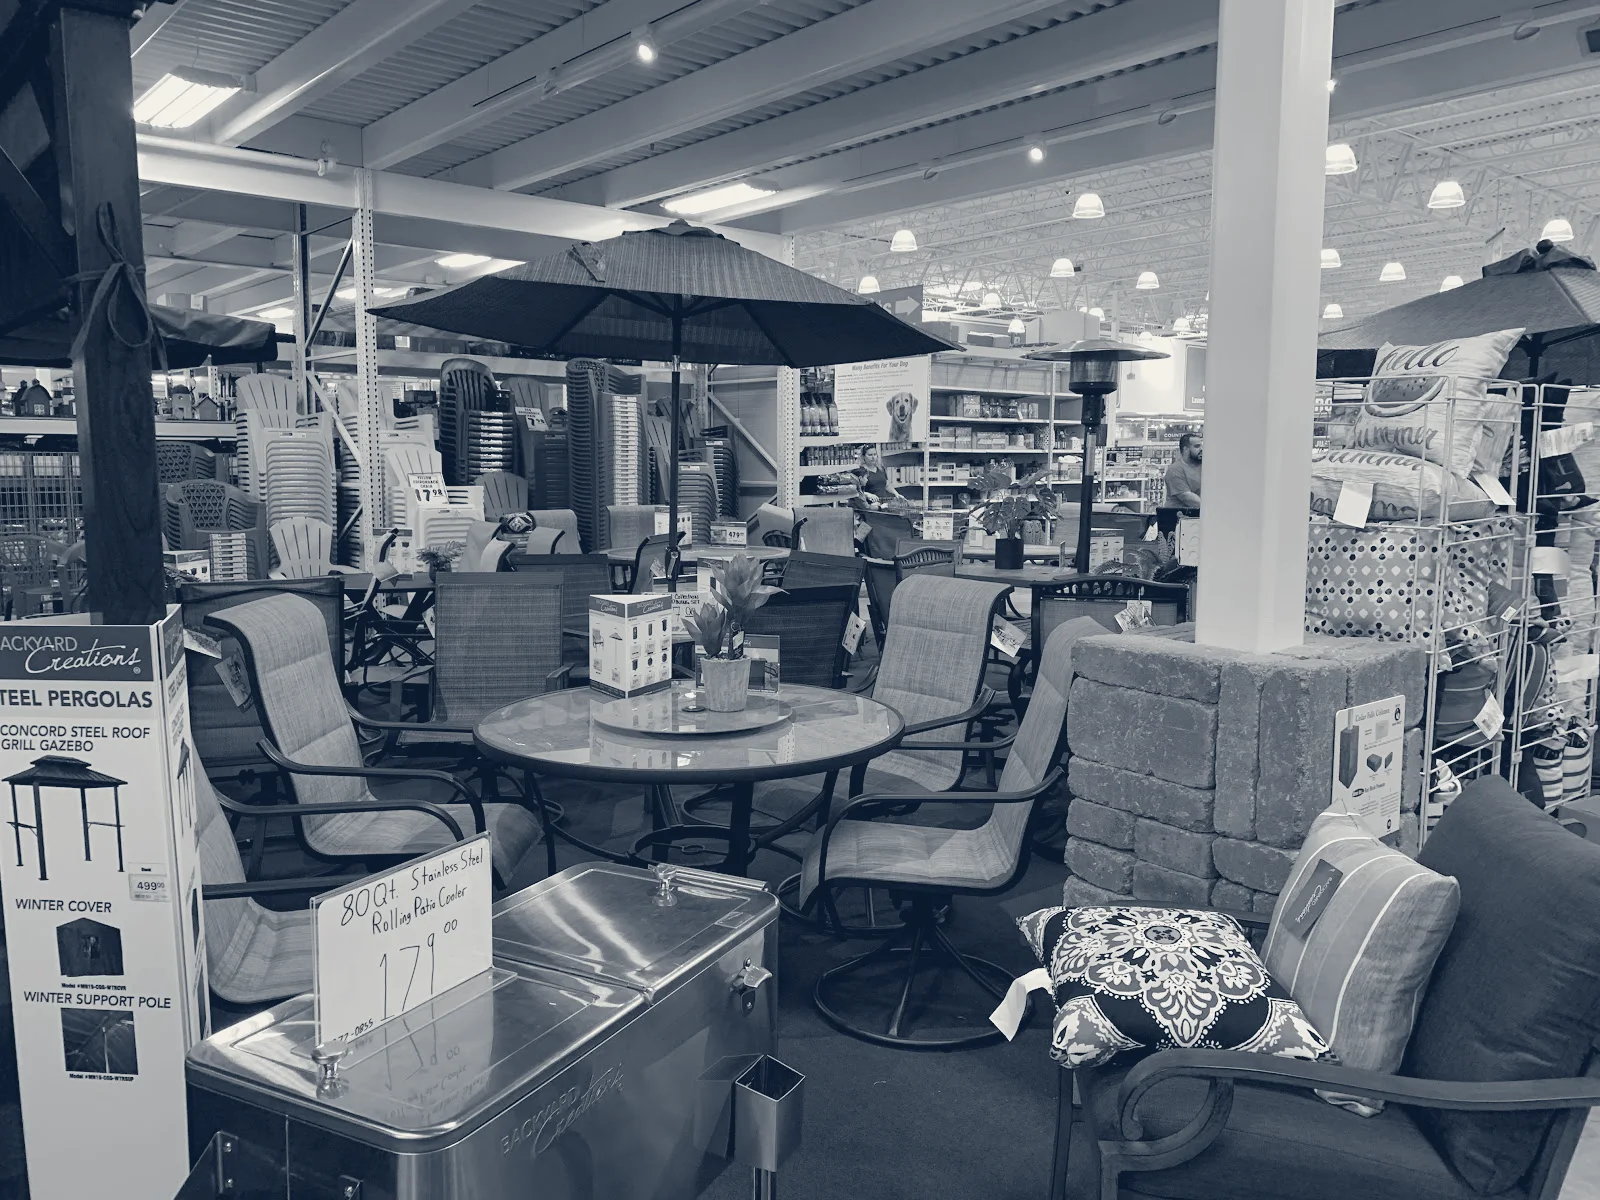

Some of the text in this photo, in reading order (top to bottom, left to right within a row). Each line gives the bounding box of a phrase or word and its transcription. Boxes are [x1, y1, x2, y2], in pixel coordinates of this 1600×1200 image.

[1351, 426, 1438, 450] ummer
[0, 636, 77, 652] ACKYARD
[25, 638, 142, 674] Creations
[0, 690, 153, 708] TEEL PERGOLAS
[1, 725, 150, 738] CONCORD STEEL ROOF
[2, 739, 94, 751] GRILL GAZEBO
[411, 861, 458, 891] Stainless
[461, 847, 483, 870] Steel
[16, 899, 111, 913] WINTER COVER
[372, 884, 467, 934] Rolling Patio Cooler
[380, 919, 458, 1021] 179 00
[24, 991, 171, 1008] WINTER SUPPORT POLE
